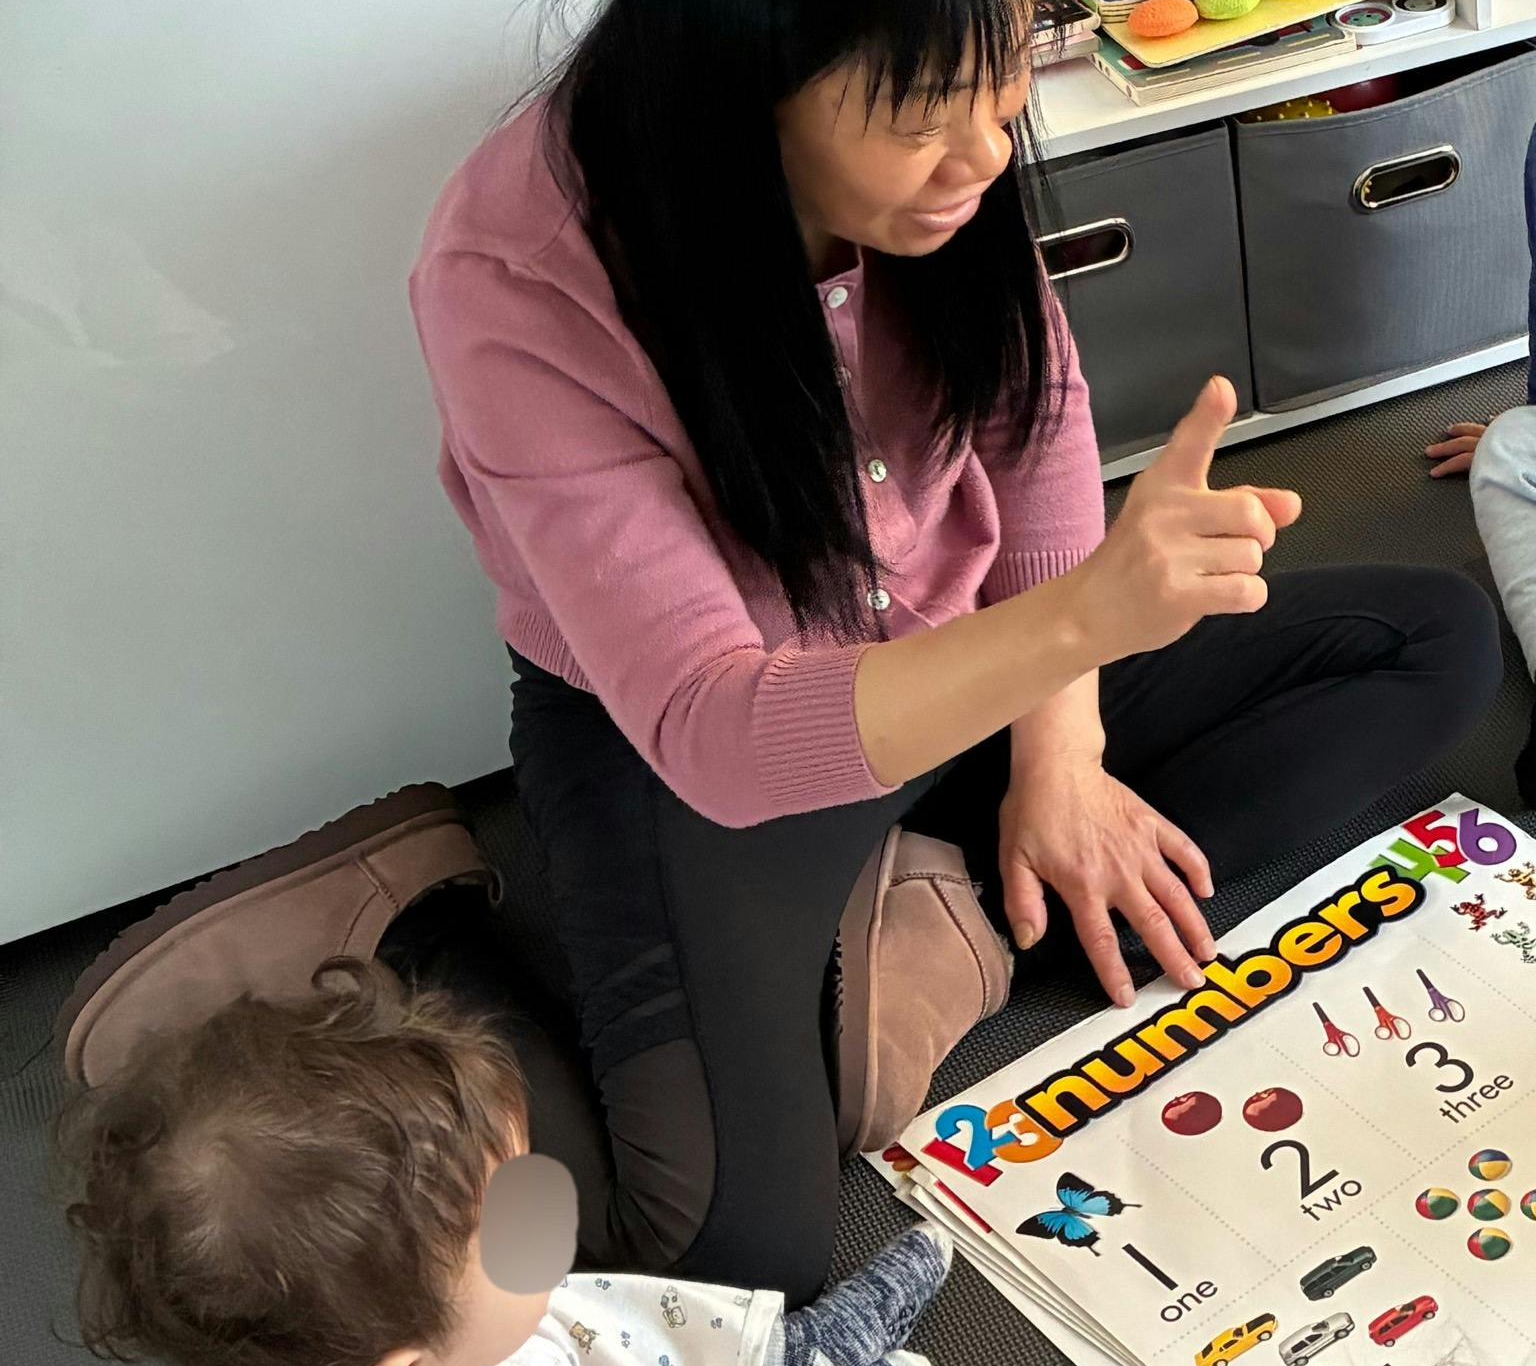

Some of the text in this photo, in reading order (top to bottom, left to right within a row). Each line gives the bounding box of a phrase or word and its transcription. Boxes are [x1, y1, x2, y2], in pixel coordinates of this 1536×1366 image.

[1018, 865, 1427, 1136] numbers
[1405, 1040, 1476, 1096] 3
[1439, 1071, 1515, 1127] three
[1260, 1138, 1342, 1198] 2
[1300, 1177, 1364, 1224] two
[1122, 1242, 1178, 1291] 1
[1159, 1276, 1220, 1327] one
